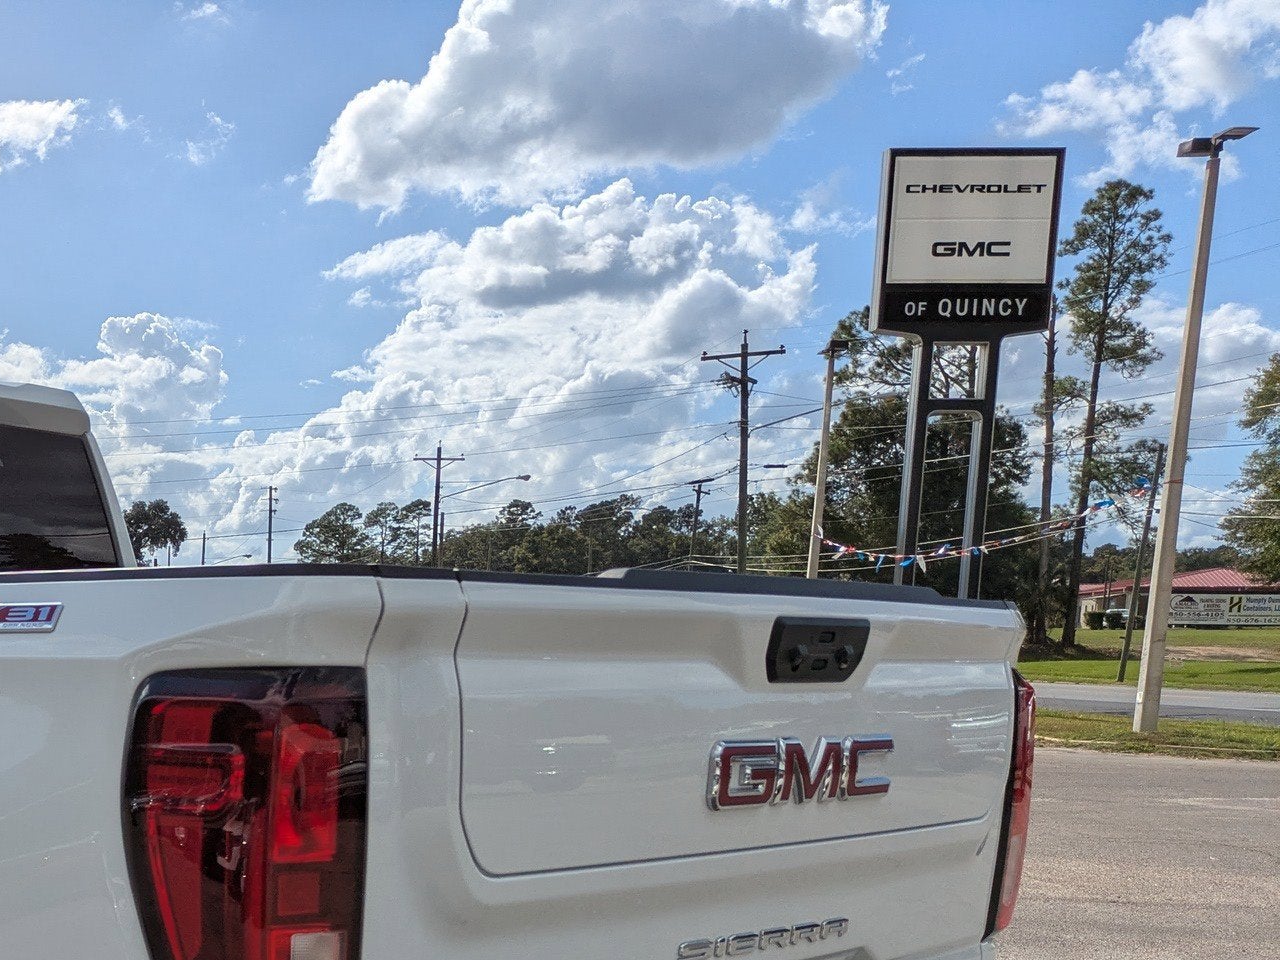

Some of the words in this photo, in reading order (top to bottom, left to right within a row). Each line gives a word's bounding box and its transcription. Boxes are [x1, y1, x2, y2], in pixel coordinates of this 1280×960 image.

[905, 184, 1047, 194] CHEVROLET
[931, 241, 1011, 257] GMC
[904, 301, 928, 316] OF
[937, 298, 1028, 317] QUINCY
[706, 734, 894, 811] GMC
